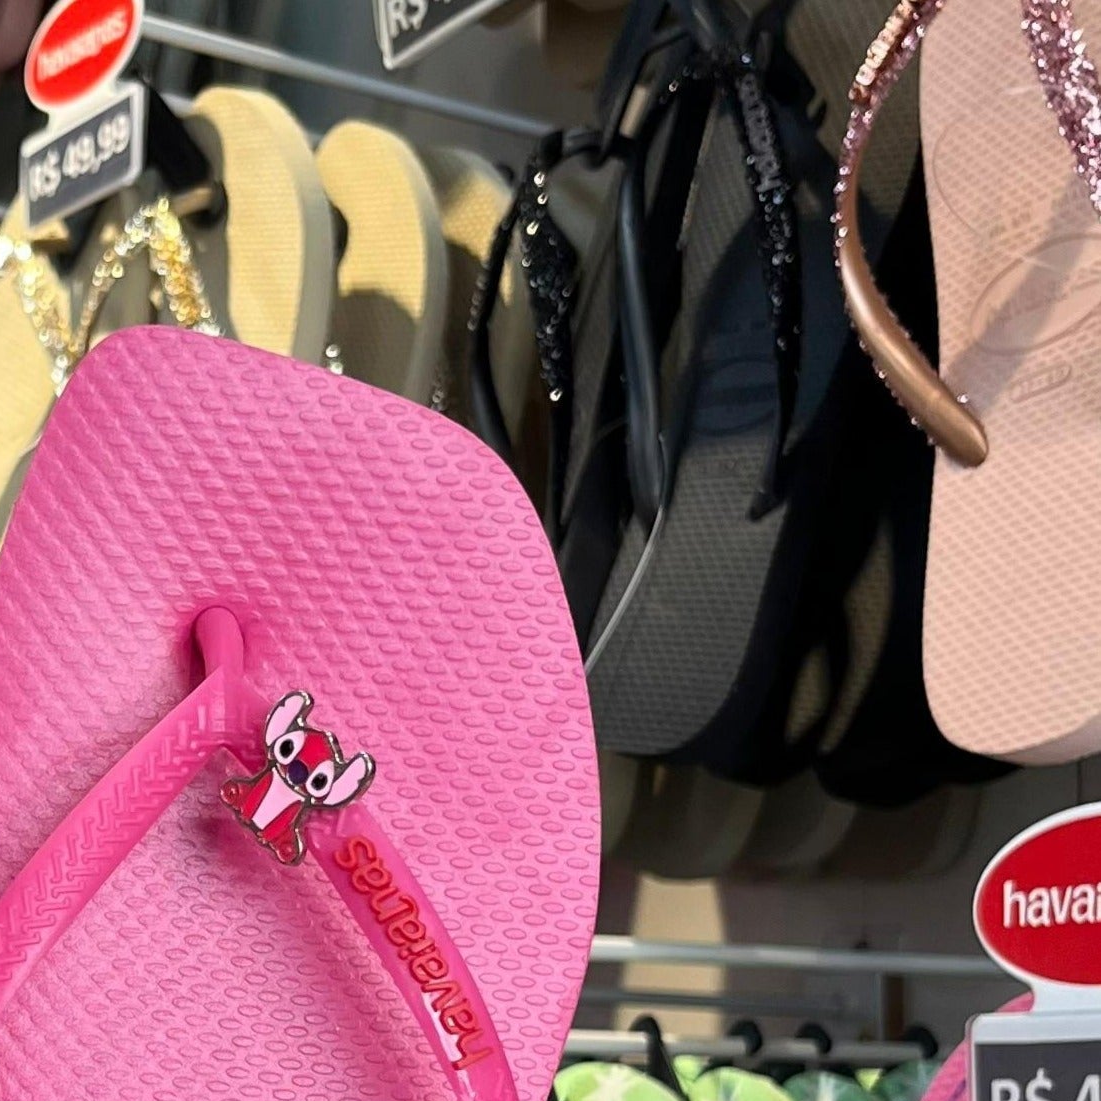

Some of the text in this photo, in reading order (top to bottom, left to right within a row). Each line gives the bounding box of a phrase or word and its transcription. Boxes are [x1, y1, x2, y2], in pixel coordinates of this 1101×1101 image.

[29, 112, 131, 202] R$ 49,99
[333, 835, 494, 1070] havaianas
